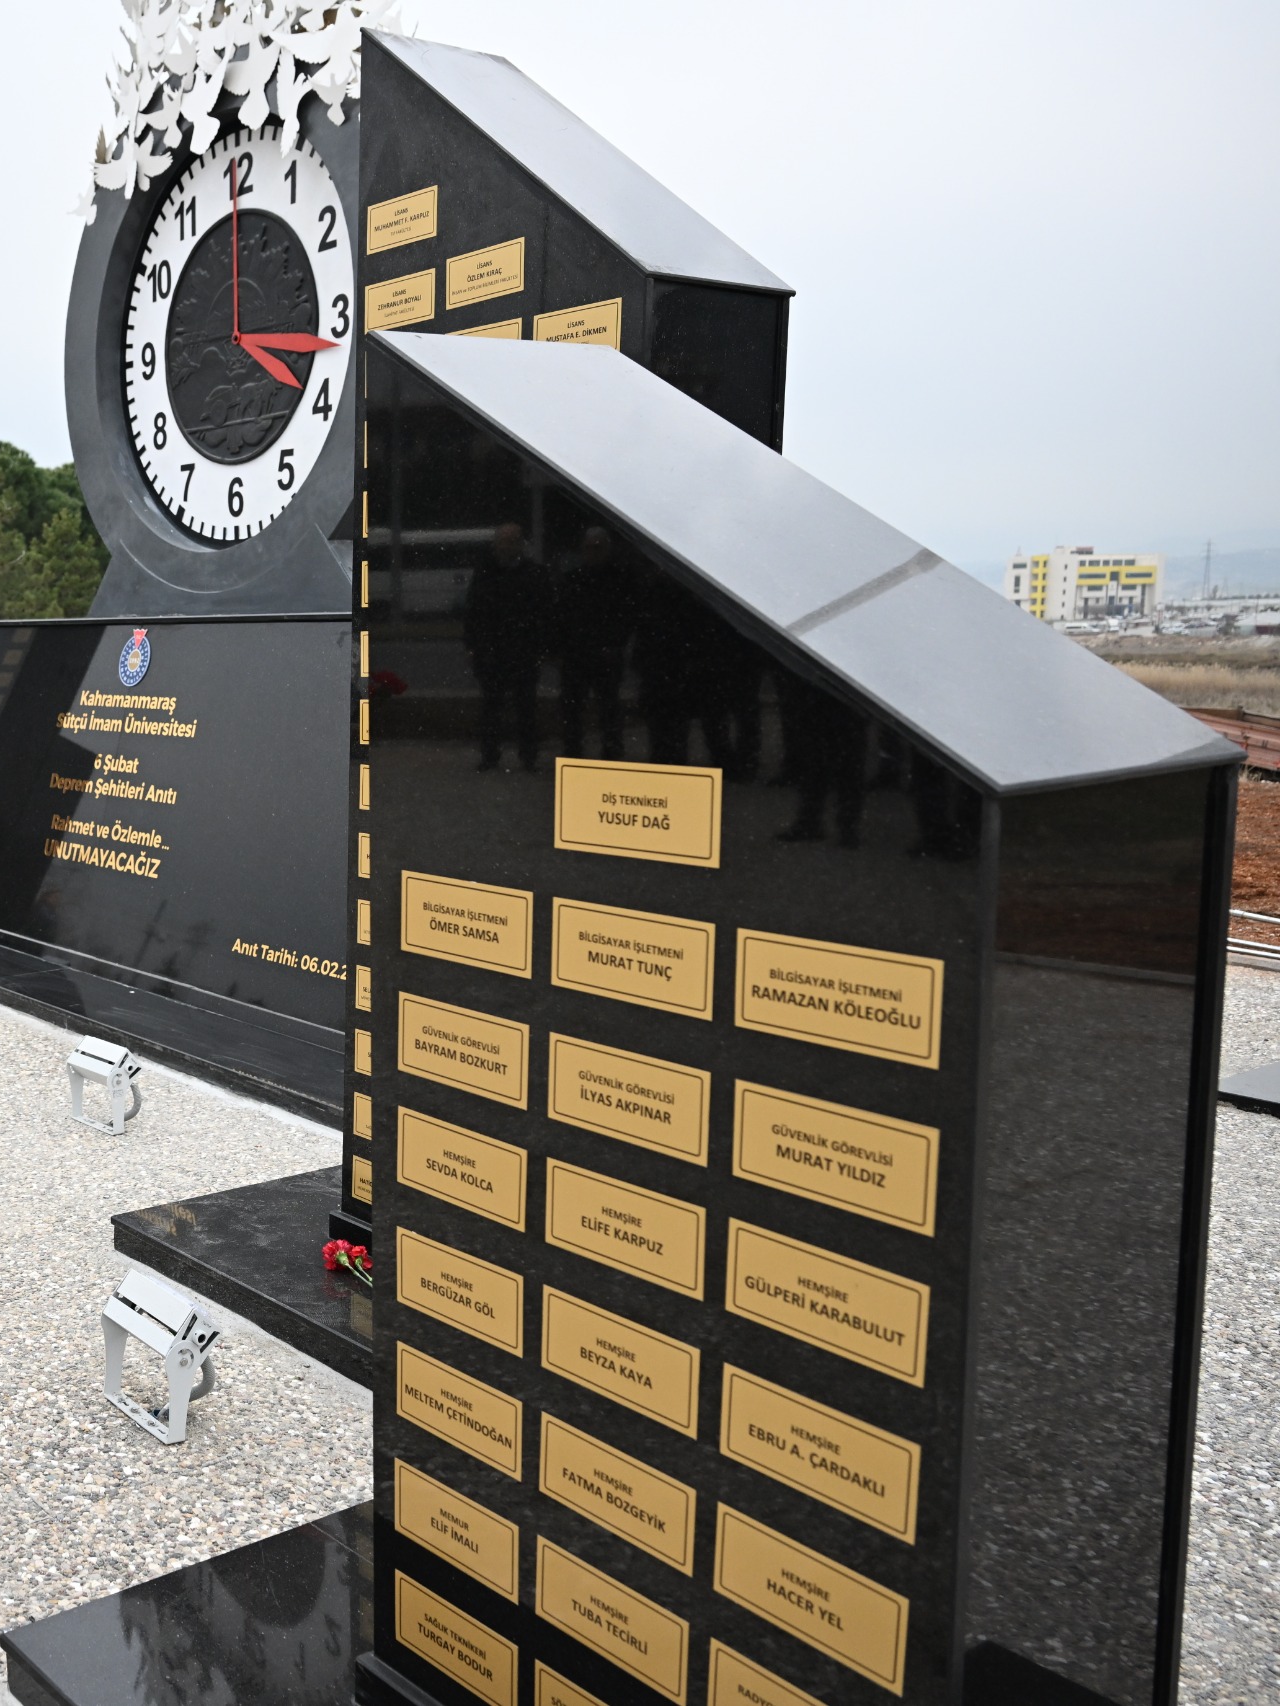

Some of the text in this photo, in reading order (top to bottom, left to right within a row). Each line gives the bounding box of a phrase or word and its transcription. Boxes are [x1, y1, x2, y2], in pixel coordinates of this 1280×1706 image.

[223, 152, 253, 201] 12
[284, 160, 297, 204] 1
[175, 196, 197, 241] 11
[318, 206, 337, 253] 2
[410, 211, 429, 221] KARPUZ
[147, 259, 172, 303] 10
[467, 268, 502, 282] ÖZLEM KIRAÇ
[477, 261, 492, 269] LİSANS
[393, 289, 406, 297] LİSANS
[330, 293, 350, 339] 3
[546, 333, 574, 342] MUSTAFA
[582, 326, 607, 336] DİKMEN
[568, 320, 585, 328] LİSANS
[141, 342, 156, 381] 9
[312, 377, 333, 422] 4
[153, 412, 167, 450] 8
[180, 463, 196, 503] 7
[277, 448, 295, 491] 5
[227, 476, 244, 518] 6
[80, 690, 177, 715] Kahramanmaraş
[56, 711, 197, 738] Sütçü İmam Üniversitesi
[94, 753, 139, 775] 6 Şubat
[50, 773, 177, 805] Deprem Şehitleri Anıtı
[601, 791, 668, 809] DİŞ TEKNİKERİ
[51, 814, 94, 837] Rahmet
[96, 824, 109, 838] ve
[597, 810, 671, 832] YUSUF DAĞ
[44, 838, 161, 879] UNUTMAYACAĞIZ
[422, 900, 508, 927] BİLGİSAYAR İŞLETMENİ
[429, 916, 500, 944] ÖMER SAMSA
[232, 938, 346, 980] Anıt Tarihi: 06.02.2
[578, 930, 684, 961] BİLGİSAYAR İŞLETMENİ
[587, 950, 673, 982] MURAT TUNÇ
[769, 967, 903, 1003] BİLGİSAYAR İŞLETMENİ
[750, 984, 922, 1030] RAMAZAN KÖLEOĞLU
[414, 1038, 508, 1076] BAYRAM BOZKURT
[421, 1024, 500, 1056] GÜVENLİK GÖREVLİSİ
[578, 1068, 675, 1105] GÜVENLİK GÖREVLİSİ
[579, 1084, 672, 1125] İLYAS AKPINAR
[442, 1148, 477, 1169] HEMŞİRE
[771, 1123, 894, 1167] GÜVENLİK GÖREVLİSİ
[425, 1158, 494, 1194] SEVDA KOLCA
[775, 1143, 886, 1189] MURAT YILDIZ
[580, 1214, 664, 1256] ELİFE KARPUZ
[601, 1205, 643, 1229] HEMŞİRE
[419, 1277, 496, 1319] BERGÜZAR GÖL
[440, 1270, 474, 1293] HEMŞİRE
[797, 1275, 849, 1304] HEMŞİRE
[744, 1274, 905, 1347] GÜLPERİ KARABULUT
[579, 1346, 653, 1390] BEYZA KAYA
[595, 1337, 636, 1363] HEMŞİRE
[403, 1383, 513, 1450] MELTEM ÇETİNDOĞAN
[440, 1387, 473, 1412] HEMŞİRE
[790, 1423, 841, 1456] HEMŞİRE
[748, 1423, 886, 1498] EBRU A. ÇARDAKLI
[562, 1466, 666, 1534] FATMA BOZGEYİK
[593, 1468, 633, 1498] HEMŞİRE
[429, 1517, 479, 1554] ELİF İMALI
[439, 1507, 470, 1532] MEMUR
[780, 1568, 831, 1602] HEMŞİRE
[589, 1594, 630, 1625] HEMŞİRE
[766, 1578, 844, 1632] HACER YEL
[423, 1612, 487, 1661] SAĞLIK TEKNİKERİ
[571, 1599, 648, 1656] TUBA TECİRLİ
[416, 1623, 494, 1682] TURGAY BODUR
